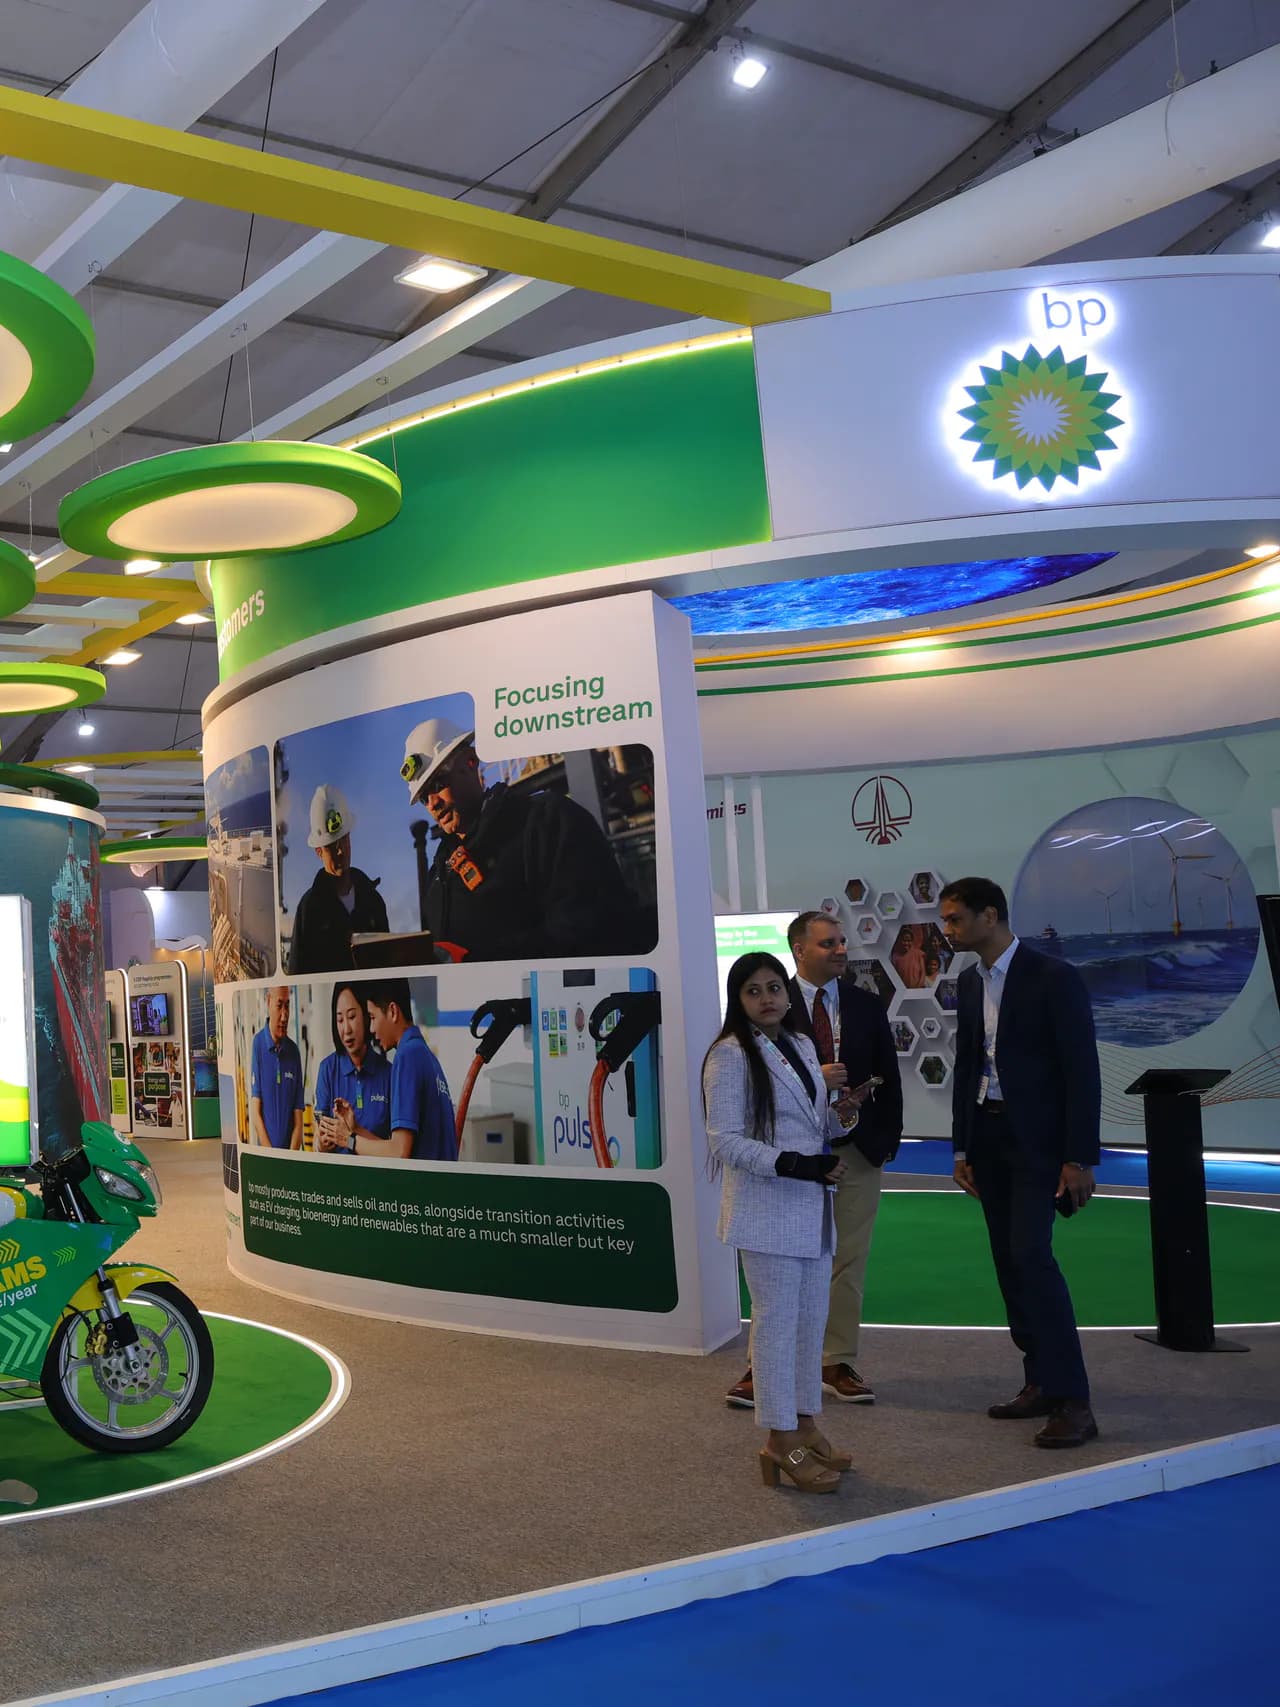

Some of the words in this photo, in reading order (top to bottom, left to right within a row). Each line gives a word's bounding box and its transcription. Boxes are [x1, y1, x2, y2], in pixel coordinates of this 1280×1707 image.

[1042, 293, 1106, 336] bp
[494, 674, 605, 710] Focusing
[493, 697, 654, 738] downstream
[370, 1093, 385, 1103] pulse
[559, 1090, 570, 1111] bp
[553, 1106, 593, 1154] puls
[301, 1190, 325, 1205] trades
[326, 1194, 342, 1206] and
[343, 1195, 364, 1210] sells
[365, 1198, 377, 1211] oil
[378, 1200, 398, 1214] and
[400, 1203, 422, 1217] gas,
[424, 1203, 483, 1222] alongside
[486, 1207, 552, 1226] transition
[555, 1212, 626, 1231] activities
[302, 1207, 341, 1227] bioenergy
[342, 1214, 359, 1227] and
[360, 1216, 419, 1235] renewables
[420, 1222, 443, 1238] that
[446, 1226, 467, 1239] are
[469, 1228, 477, 1240] a
[479, 1228, 517, 1243] much
[520, 1231, 573, 1248] smaller
[577, 1234, 604, 1250] but
[607, 1235, 635, 1255] key
